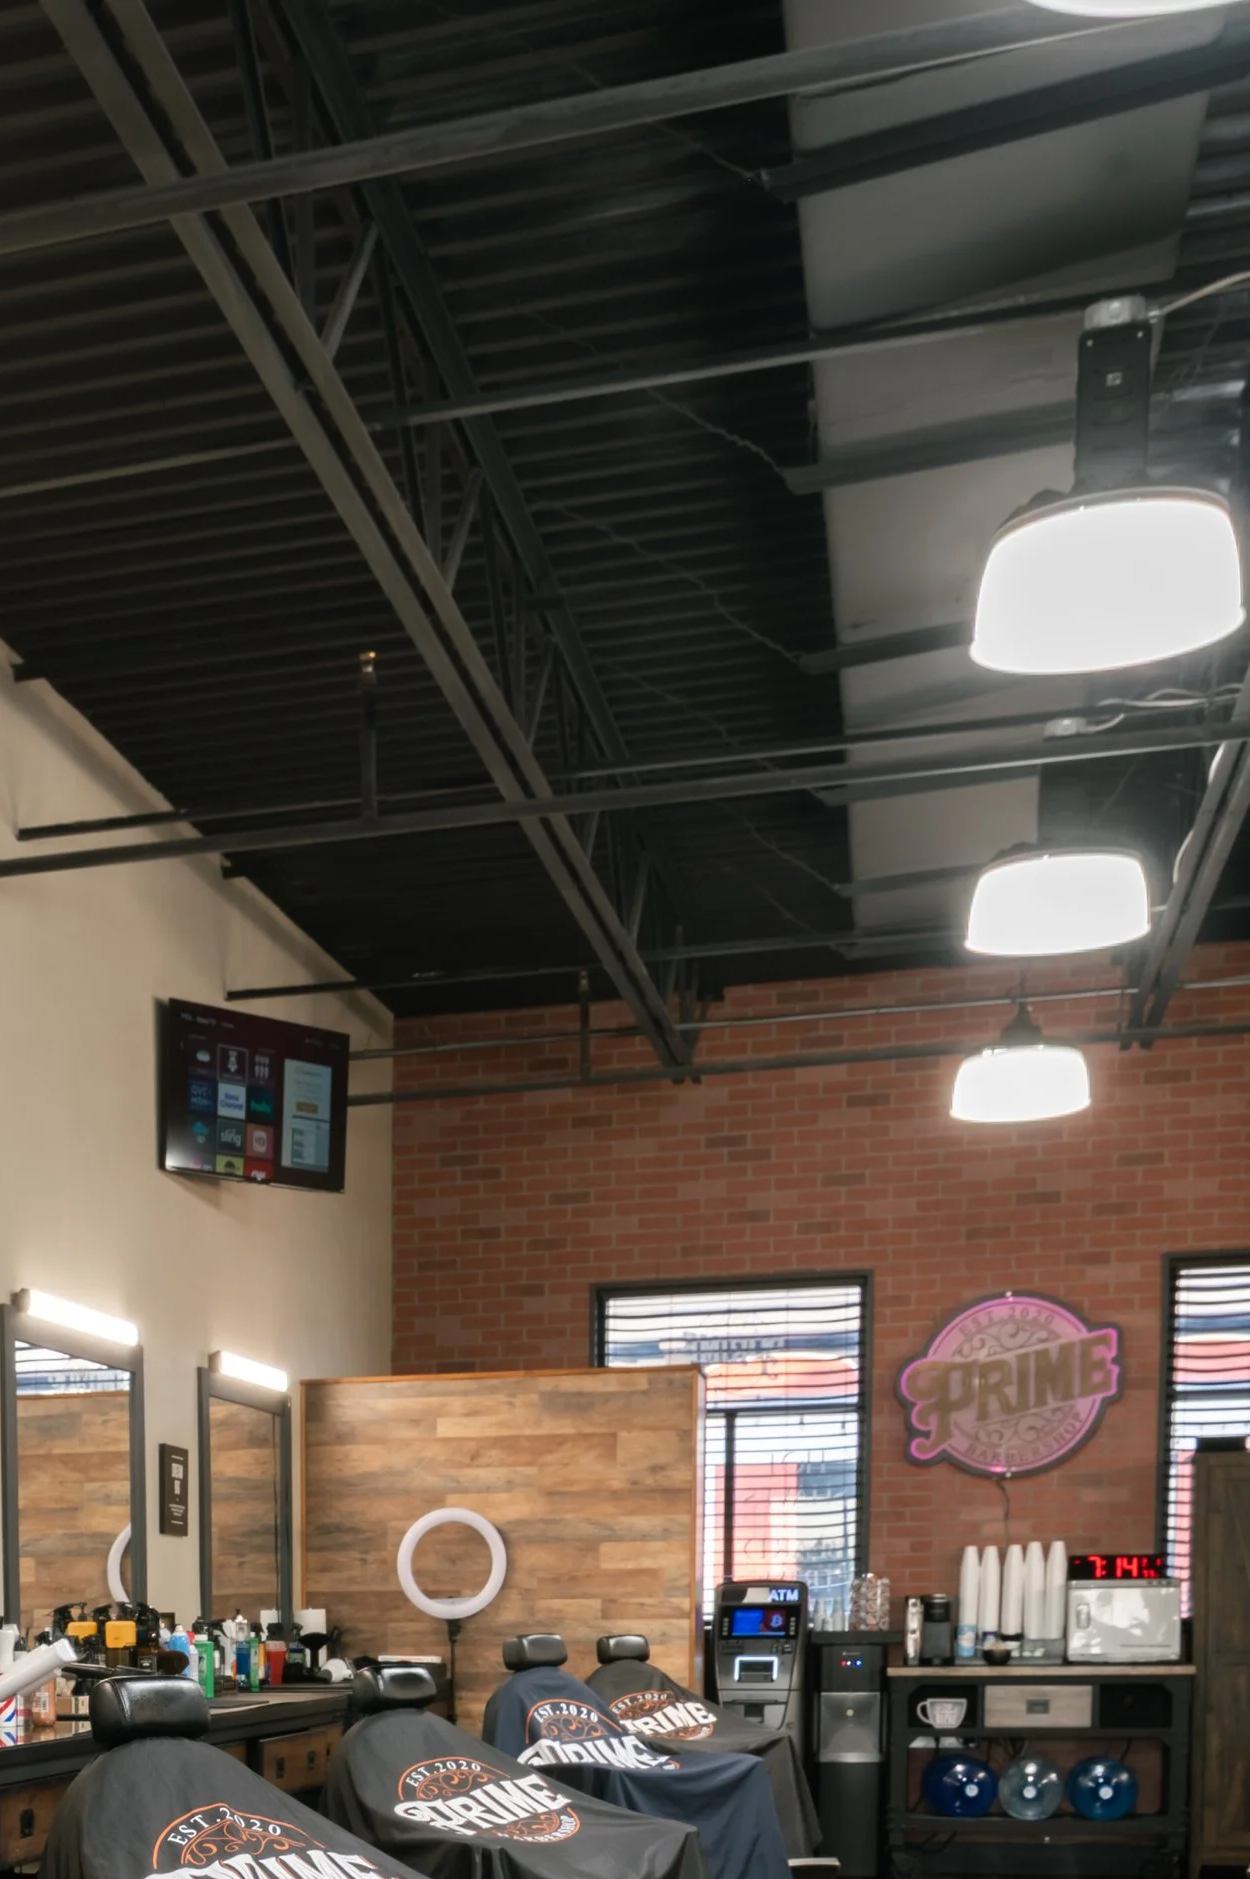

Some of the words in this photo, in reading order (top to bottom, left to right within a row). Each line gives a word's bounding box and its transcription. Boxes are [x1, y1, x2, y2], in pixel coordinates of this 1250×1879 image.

[903, 1331, 1117, 1457] PRIME
[768, 1589, 799, 1601] ATM
[393, 1773, 572, 1836] PRIME
